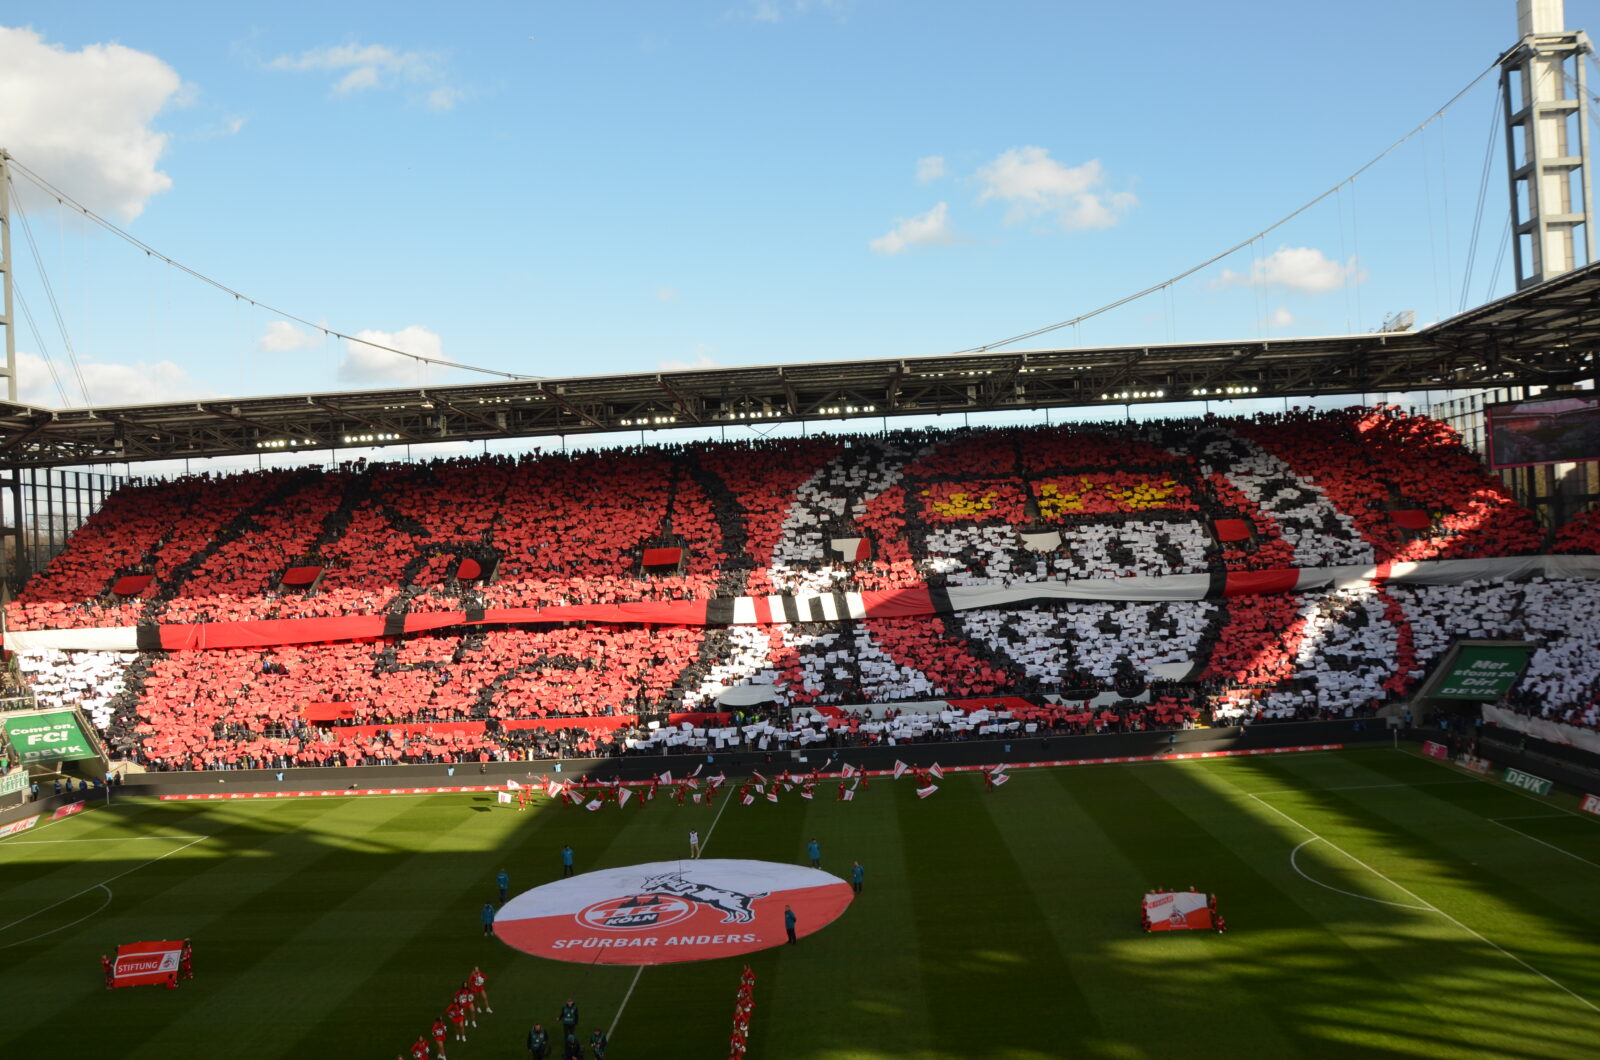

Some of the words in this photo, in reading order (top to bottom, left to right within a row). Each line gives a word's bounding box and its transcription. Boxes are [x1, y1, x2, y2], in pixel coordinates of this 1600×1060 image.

[1471, 660, 1509, 669] Mer
[1461, 678, 1500, 686] Dir!
[10, 725, 51, 736] Come
[27, 731, 68, 745] FC!
[24, 745, 83, 759] DEVK
[1506, 771, 1545, 793] DEVK
[605, 914, 657, 925] KÖLN
[552, 937, 658, 949] SPÜRBAR
[664, 933, 763, 946] ANDERS.
[118, 961, 158, 973] STIFTUNG
